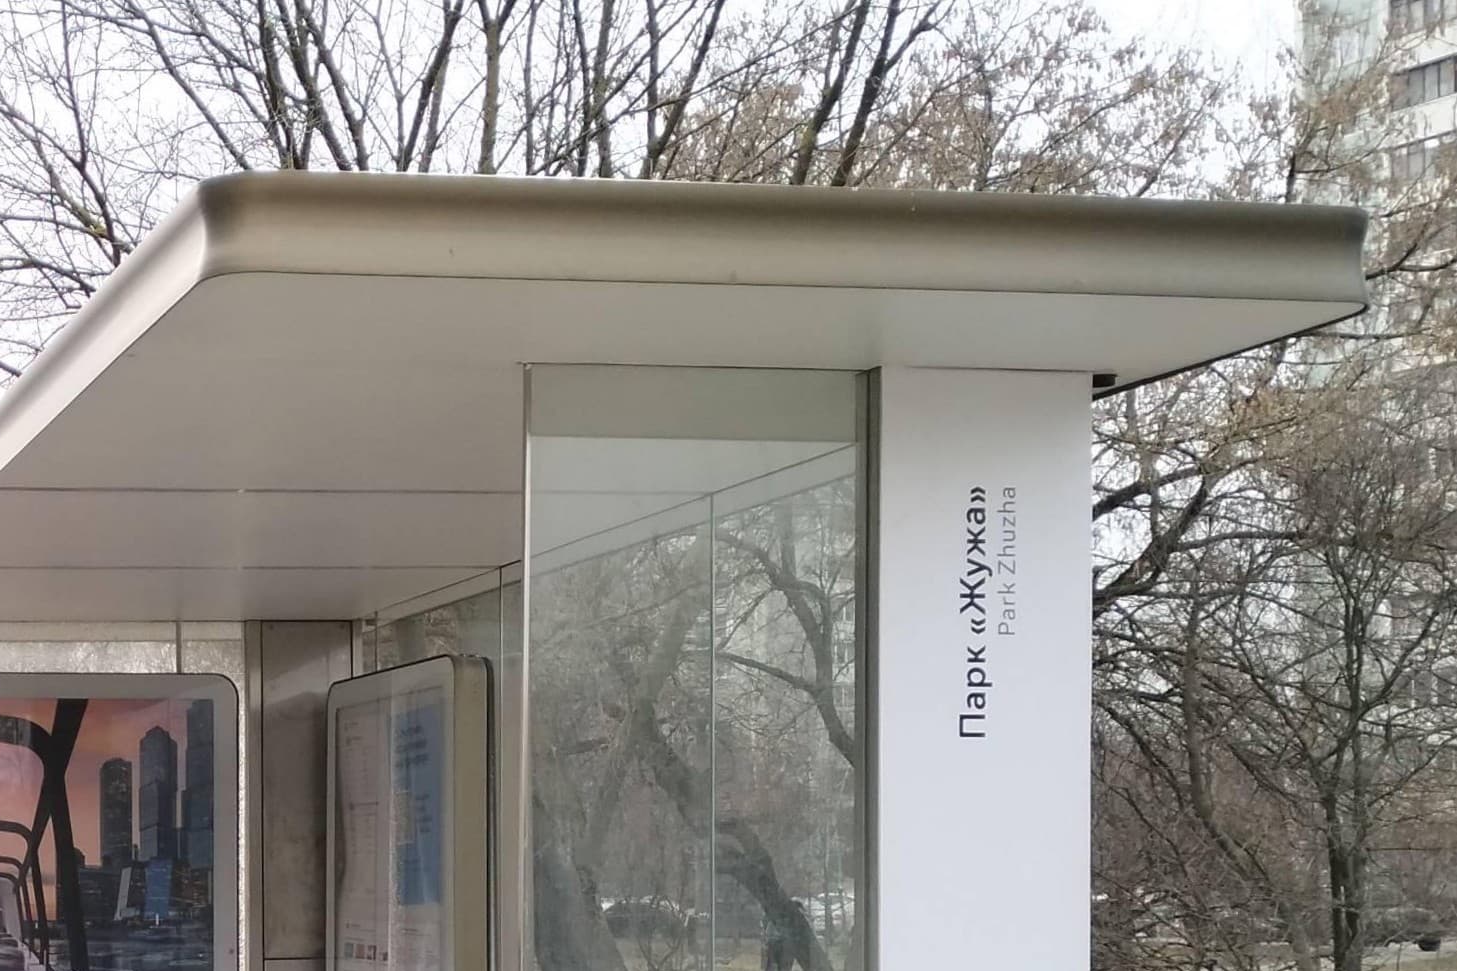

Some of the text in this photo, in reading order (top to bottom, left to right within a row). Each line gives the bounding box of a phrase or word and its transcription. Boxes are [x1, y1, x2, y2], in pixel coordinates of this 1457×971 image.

[959, 486, 993, 738] Парк «Жужа»
[997, 487, 1016, 636] Park Zhuzha
